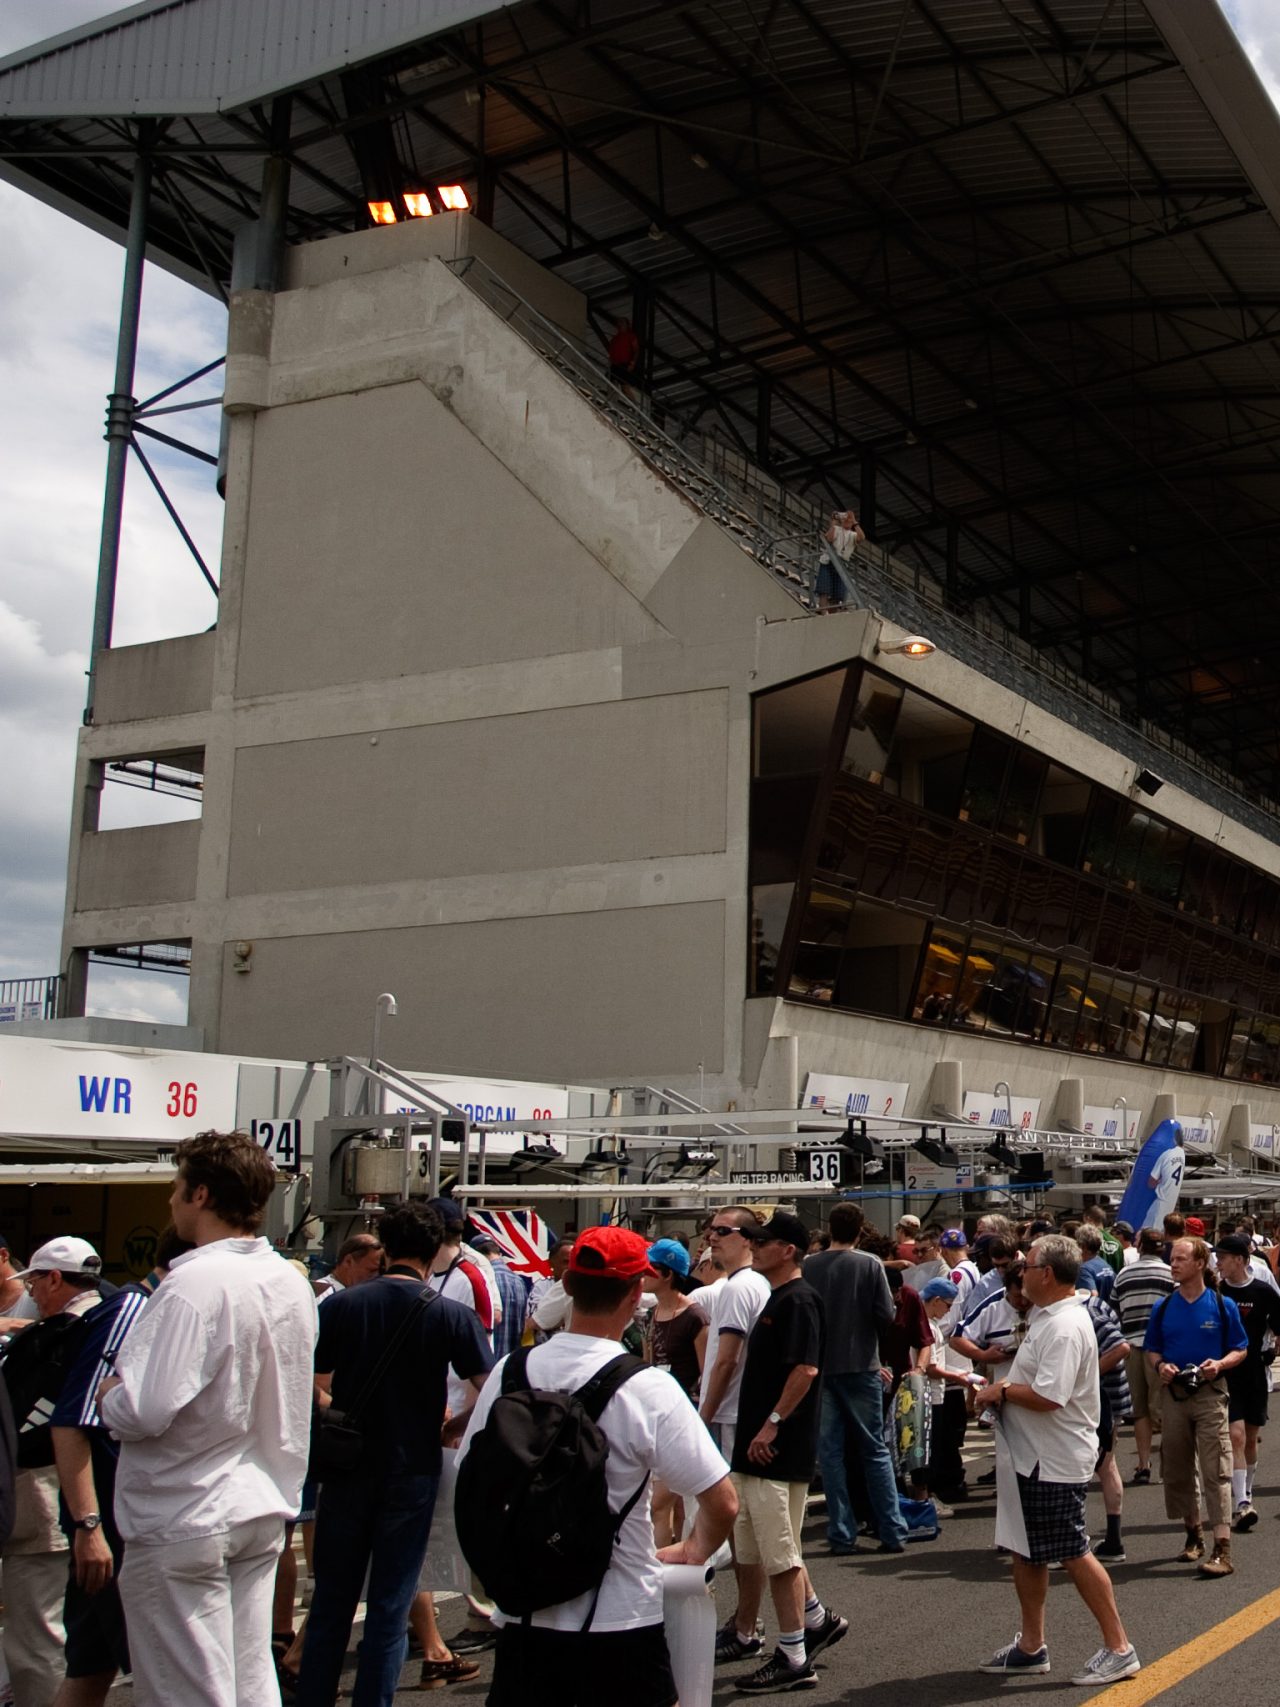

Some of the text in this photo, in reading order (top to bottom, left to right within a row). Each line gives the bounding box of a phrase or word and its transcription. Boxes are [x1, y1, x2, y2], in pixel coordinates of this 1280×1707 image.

[78, 1075, 198, 1118] WR 36
[846, 1093, 893, 1117] AUDI 2
[259, 1122, 294, 1162] 24
[812, 1153, 838, 1181] 36
[1171, 1165, 1182, 1186] 4
[908, 1175, 918, 1190] 2
